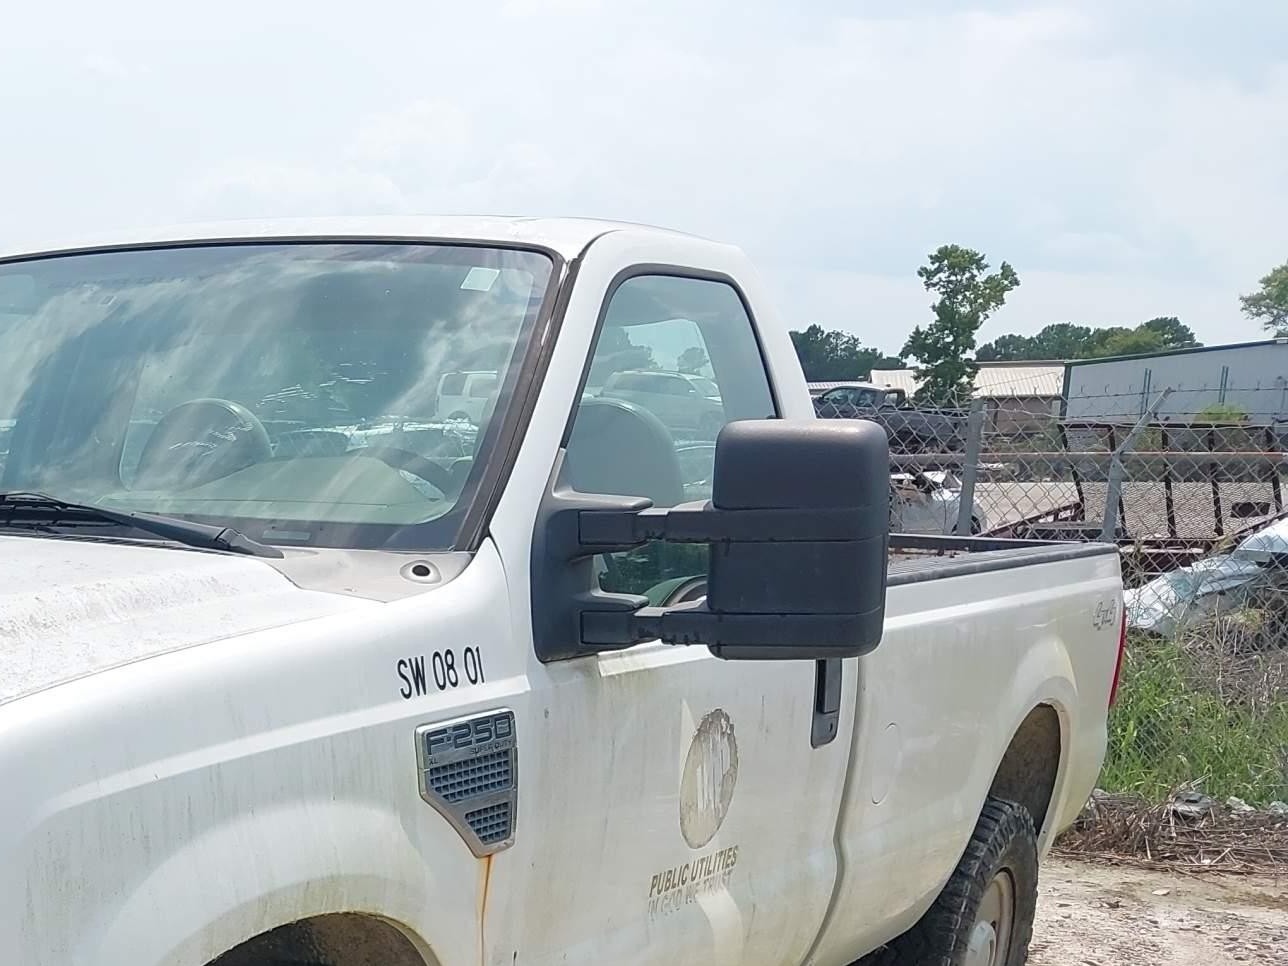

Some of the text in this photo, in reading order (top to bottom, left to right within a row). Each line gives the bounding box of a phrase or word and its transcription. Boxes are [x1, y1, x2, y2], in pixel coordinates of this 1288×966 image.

[397, 646, 485, 700] SW 08 01
[649, 845, 739, 897] PUBLIC UTILITIES
